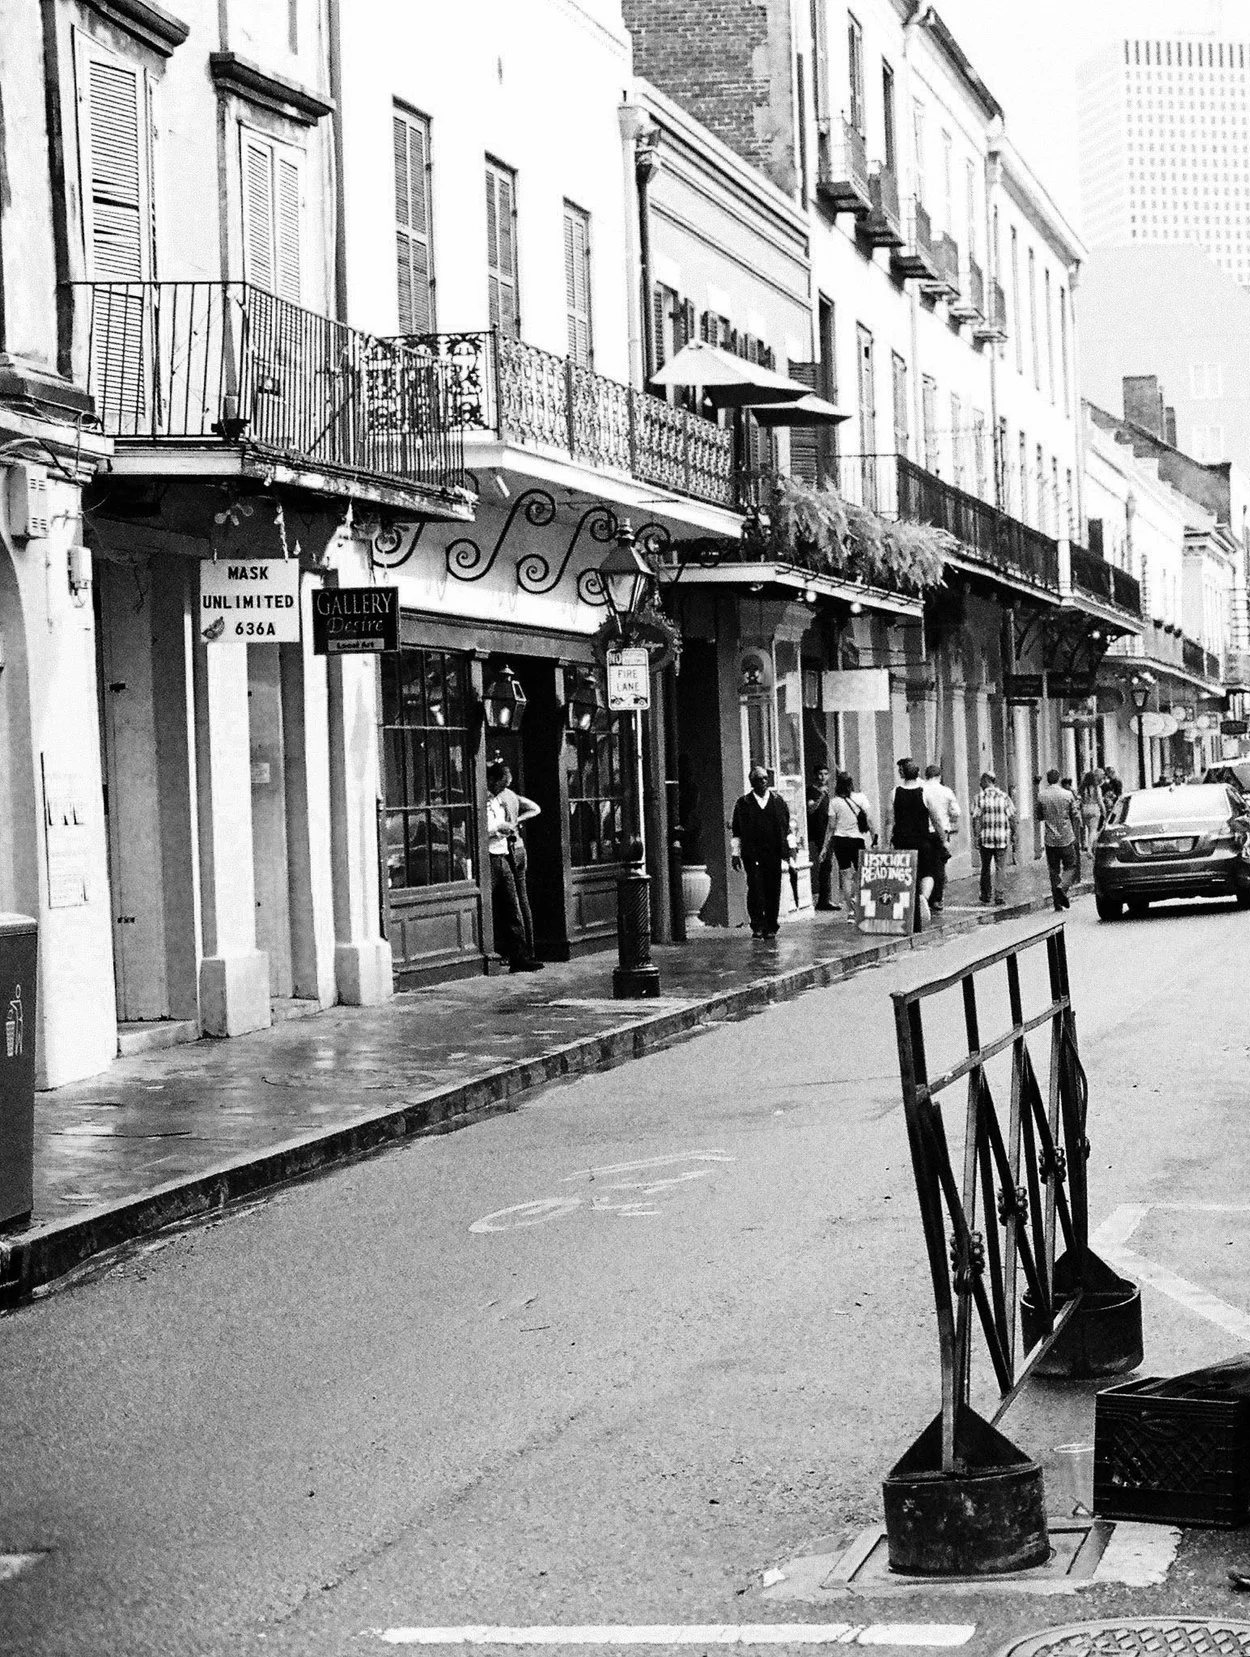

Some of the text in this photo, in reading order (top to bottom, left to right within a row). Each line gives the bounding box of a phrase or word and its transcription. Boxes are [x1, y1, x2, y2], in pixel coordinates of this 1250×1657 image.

[228, 566, 269, 580] MASK
[202, 595, 294, 609] UNLIMITED
[317, 592, 393, 616] GALLERY
[235, 622, 276, 636] 636A
[326, 616, 384, 634] Desire
[617, 669, 638, 679] FIRE
[617, 682, 640, 692] LANE
[861, 866, 913, 887] READINGS
